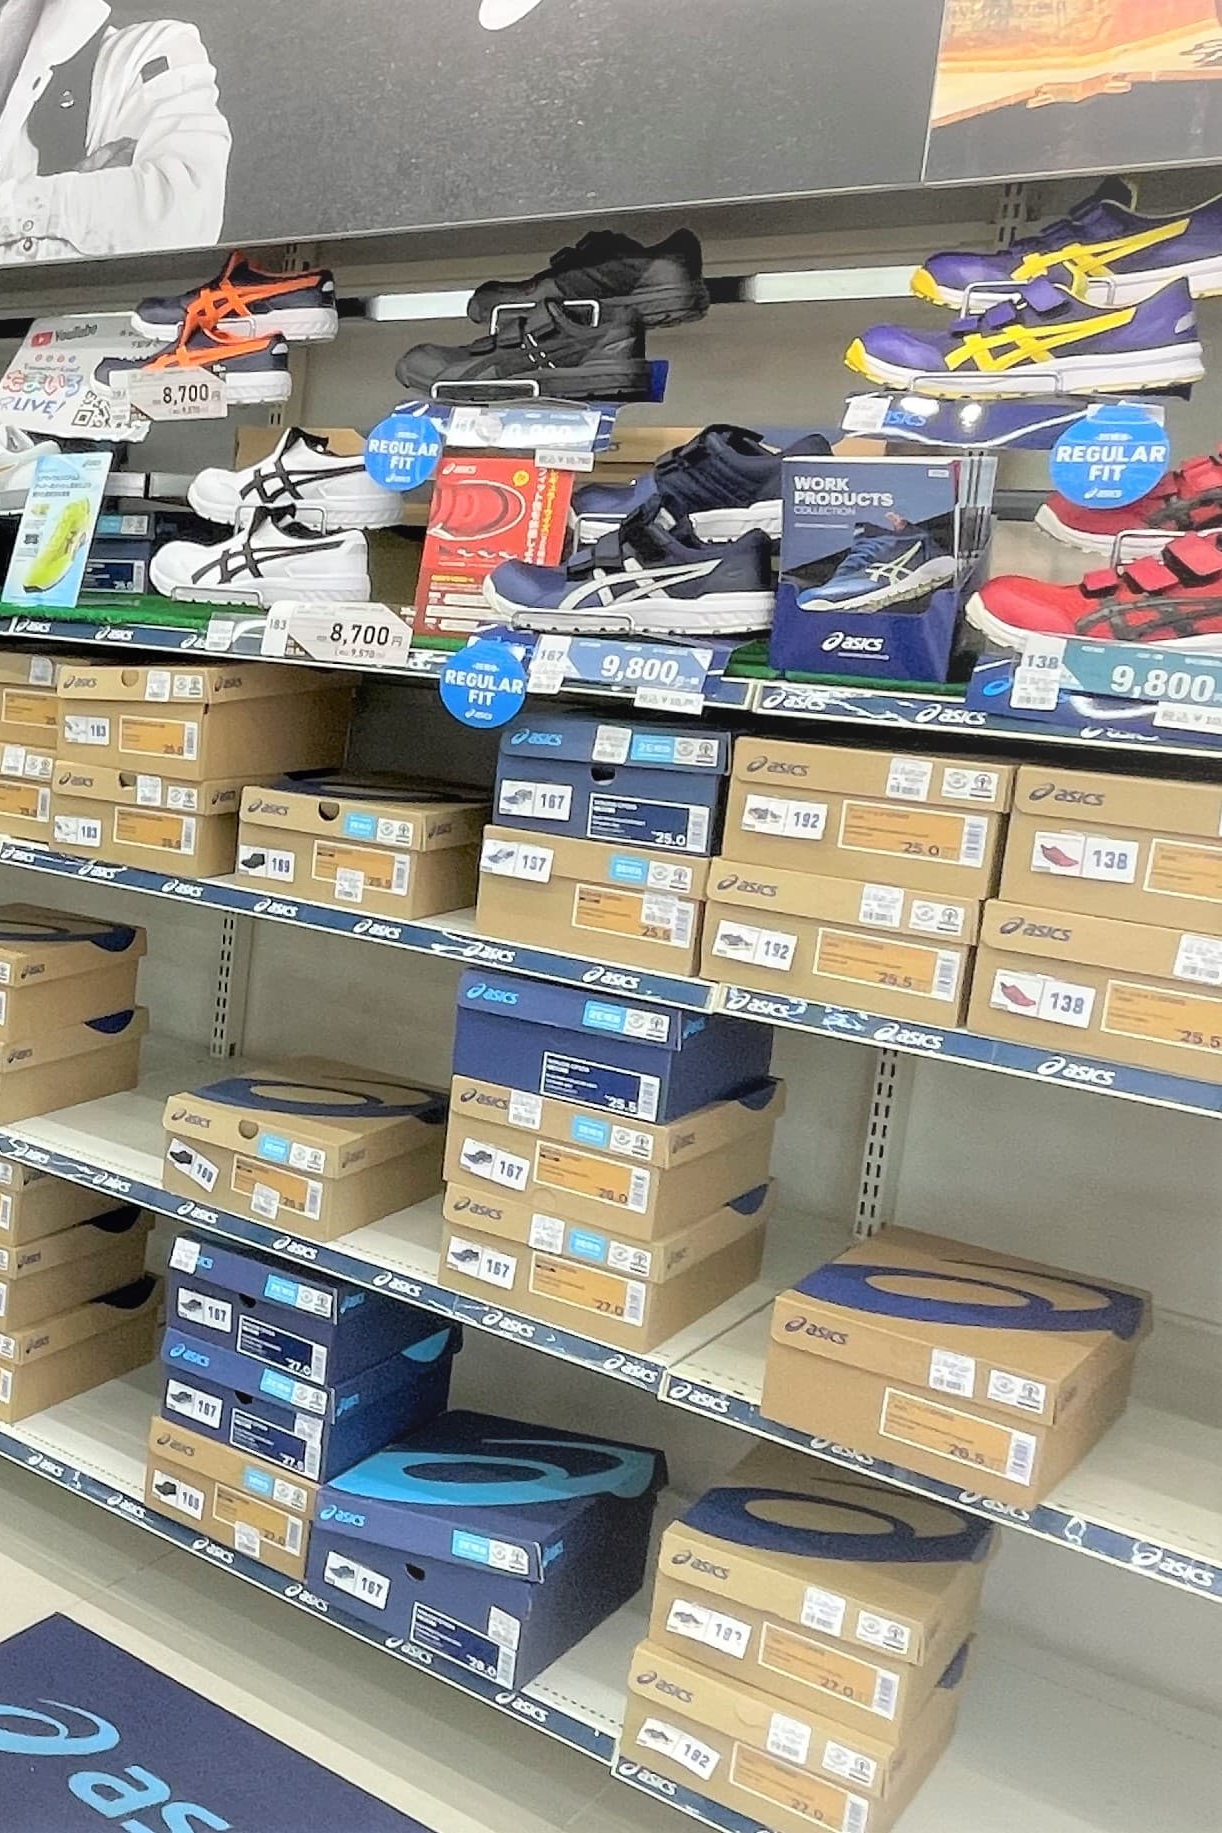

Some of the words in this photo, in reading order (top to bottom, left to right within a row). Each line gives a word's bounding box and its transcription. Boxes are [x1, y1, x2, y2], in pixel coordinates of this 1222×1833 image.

[55, 324, 98, 342] YouTube
[163, 383, 209, 406] 8,700
[885, 410, 927, 427] sics
[368, 440, 438, 457] REGULAR
[1056, 445, 1166, 464] REGULAR
[389, 456, 415, 470] FIT
[1088, 464, 1127, 482] FIT
[794, 475, 850, 491] WORK
[794, 491, 894, 507] PRODUCTS
[794, 506, 856, 516] COLLECTION
[28, 621, 52, 632] asics
[268, 617, 287, 632] 183
[106, 628, 134, 641] asics
[330, 623, 390, 647] 8,700
[840, 636, 884, 652] asics
[540, 650, 564, 663] 167
[1026, 654, 1059, 670] 138
[601, 654, 678, 685] 9,800
[74, 677, 97, 689] asics
[445, 669, 523, 694] REGULAR
[1111, 664, 1216, 703] 9,800
[468, 689, 496, 706] FIT
[782, 693, 826, 713] asics
[939, 708, 988, 727] asics
[527, 731, 562, 746] asics
[767, 761, 810, 777] asics
[71, 776, 94, 788] asics
[540, 793, 565, 810] 167
[1054, 788, 1105, 808] asics
[261, 803, 290, 817] asics
[792, 810, 820, 829] 192
[655, 831, 686, 847] 25.0
[1092, 849, 1128, 871] 138
[177, 884, 204, 898] asics
[736, 880, 779, 898] asics
[270, 904, 299, 918] asics
[369, 925, 402, 940] asics
[1022, 924, 1073, 943] asics
[481, 949, 516, 963] asics
[764, 939, 791, 960] 192
[598, 971, 641, 989] asics
[482, 989, 519, 1005] asics
[1049, 992, 1084, 1015] 138
[742, 998, 791, 1019] asics
[893, 1029, 944, 1050] asics
[1062, 1063, 1116, 1087] asics
[476, 1092, 509, 1110] asics
[184, 1114, 211, 1129] asics
[499, 1159, 523, 1181] 167
[190, 1207, 219, 1225] asics
[469, 1201, 503, 1221] asics
[286, 1241, 319, 1261] asics
[486, 1257, 510, 1278] 167
[390, 1277, 423, 1297] asics
[208, 1305, 227, 1324] 167
[498, 1317, 535, 1338] asics
[806, 1323, 849, 1345] asics
[184, 1352, 210, 1368] asics
[621, 1363, 658, 1384] asics
[692, 1388, 731, 1414] asics
[169, 1440, 195, 1457] asics
[334, 1511, 366, 1527] asics
[207, 1547, 235, 1565] asics
[690, 1558, 730, 1580] asics
[1158, 1556, 1216, 1588] asics
[361, 1577, 383, 1598] 167
[298, 1592, 329, 1612] asics
[655, 1679, 693, 1704] asics
[511, 1698, 549, 1723] asics
[683, 1742, 711, 1769] 192
[637, 1770, 677, 1796] asics
